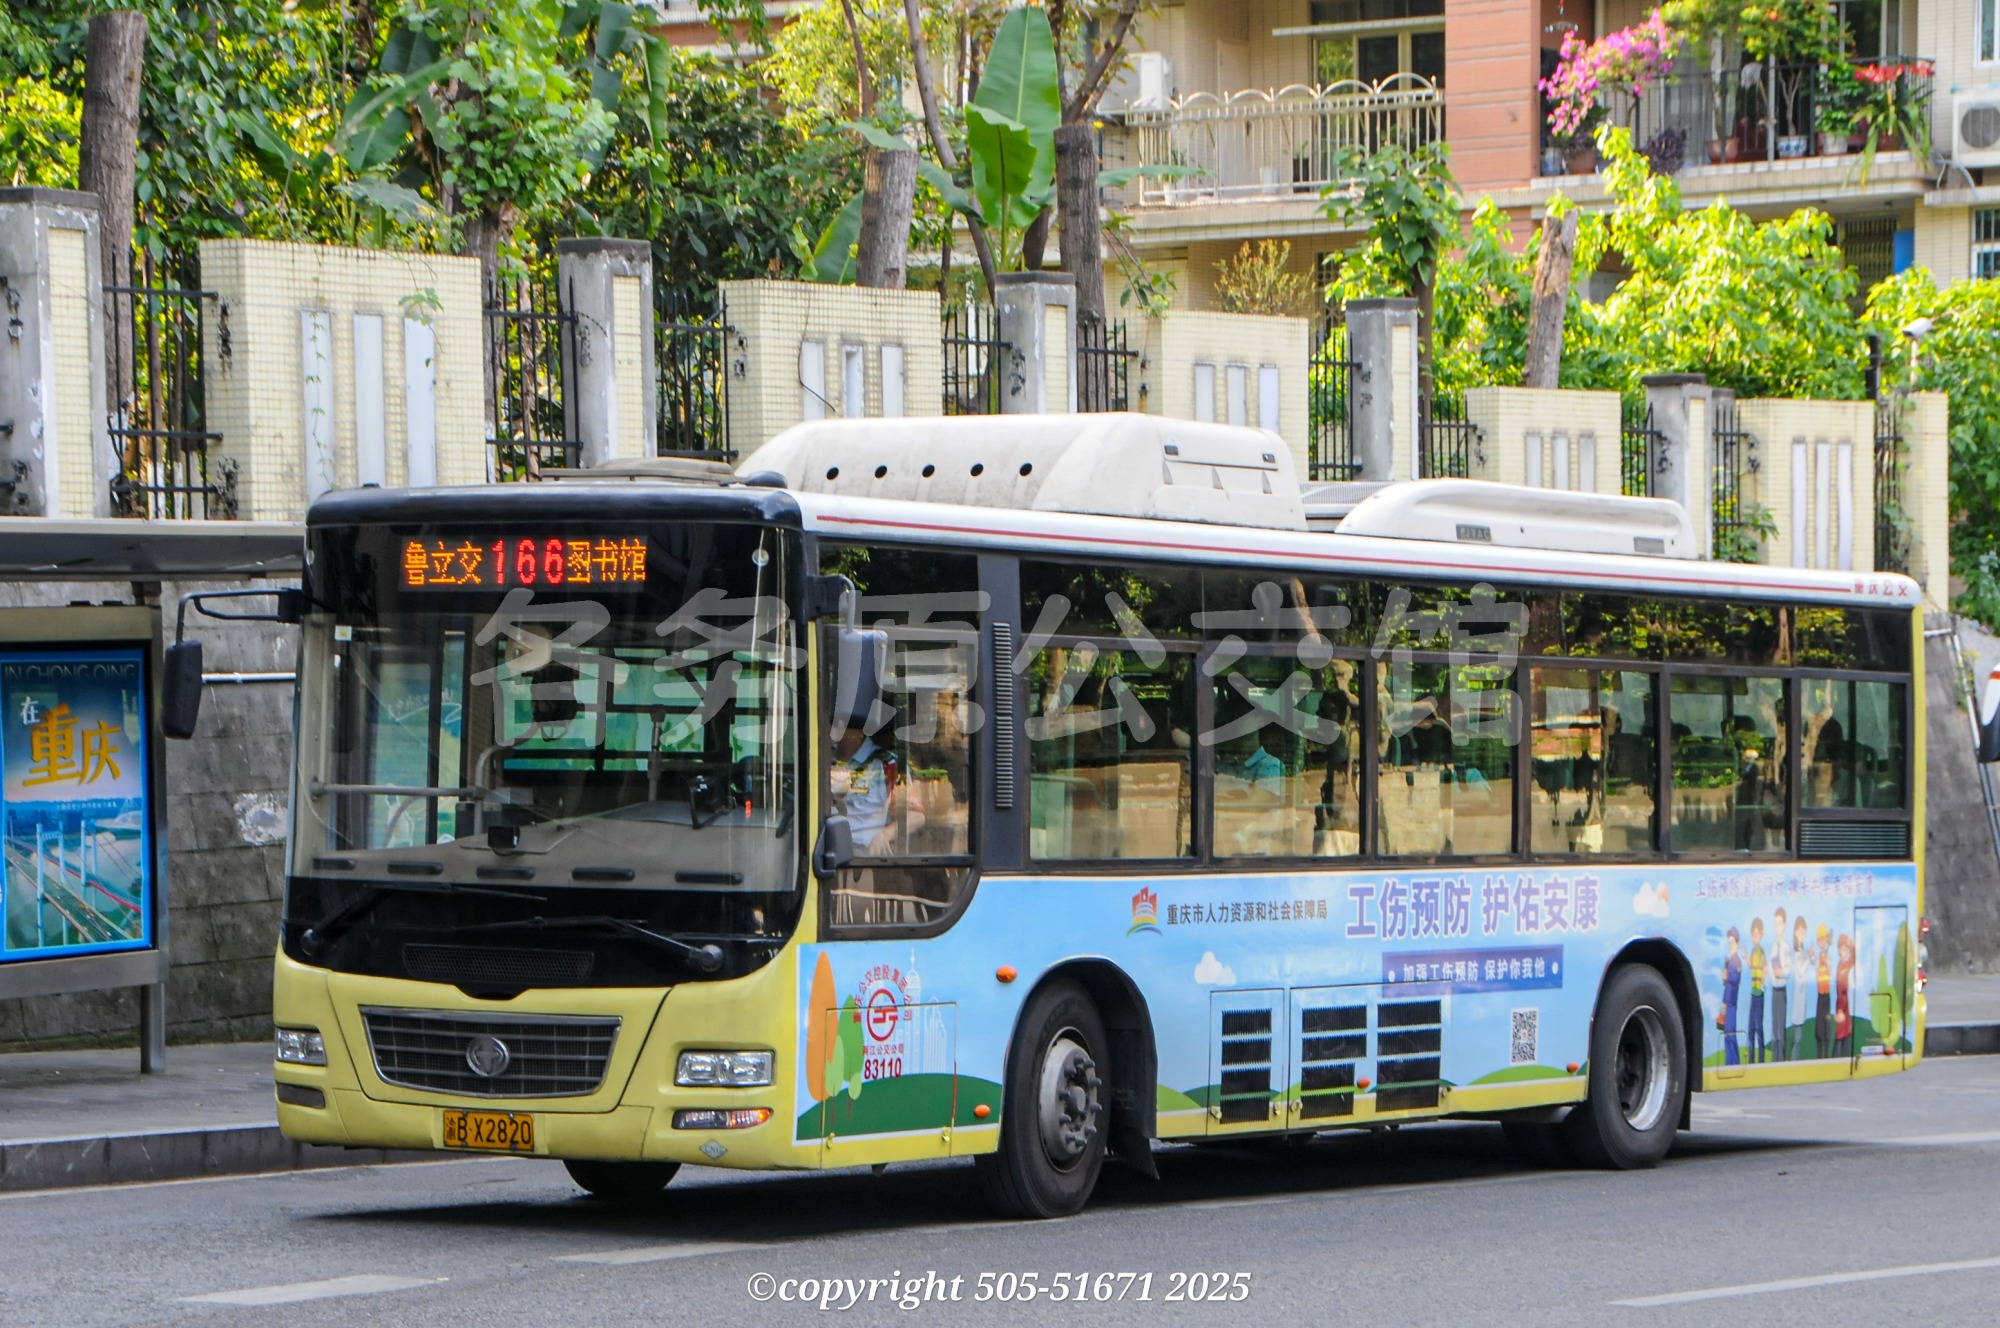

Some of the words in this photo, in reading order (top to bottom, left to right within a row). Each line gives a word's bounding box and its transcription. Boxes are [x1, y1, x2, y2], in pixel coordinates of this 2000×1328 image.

[404, 540, 482, 585] 鲁立交
[492, 539, 563, 584] 166
[567, 538, 647, 584] 图书馆
[20, 696, 40, 725] 在
[22, 701, 122, 788] 重庆
[1166, 899, 1328, 926] 重庆市人力资源和社会保障局
[1345, 877, 1472, 939] 工伤预防
[1481, 873, 1600, 934] 护佑安康
[1402, 960, 1479, 983] 加强工伤预防
[1485, 957, 1545, 981] 保护你我他
[863, 1057, 902, 1080] 83110
